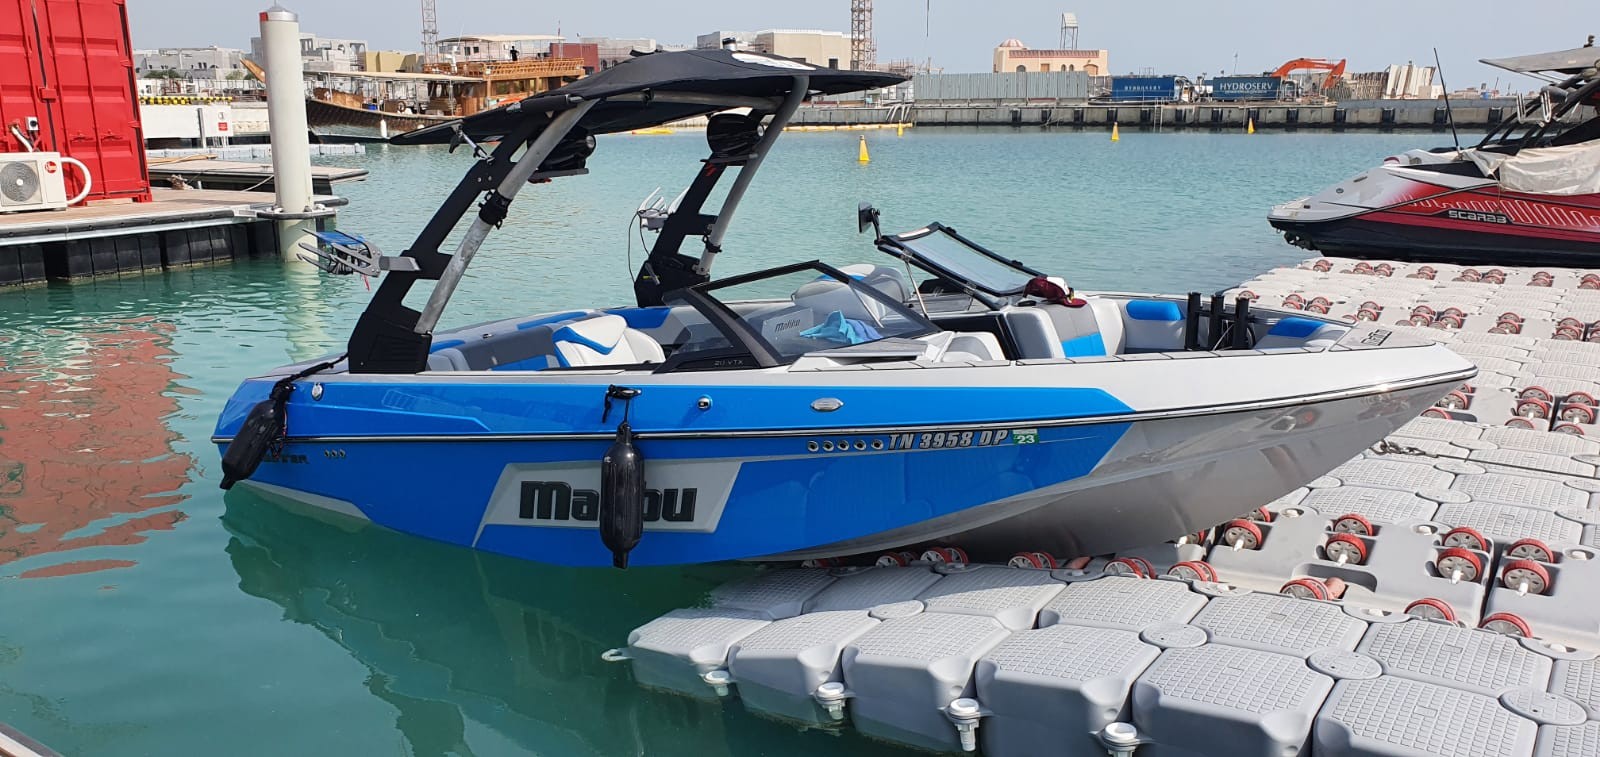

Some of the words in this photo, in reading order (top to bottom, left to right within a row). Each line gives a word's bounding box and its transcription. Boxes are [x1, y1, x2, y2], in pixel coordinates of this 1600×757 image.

[1220, 82, 1273, 91] HYDROSERV
[888, 433, 914, 450] TN
[919, 431, 974, 449] 3958
[978, 429, 1009, 446] DP
[1016, 434, 1035, 444] 23
[519, 480, 698, 522] Mabu
